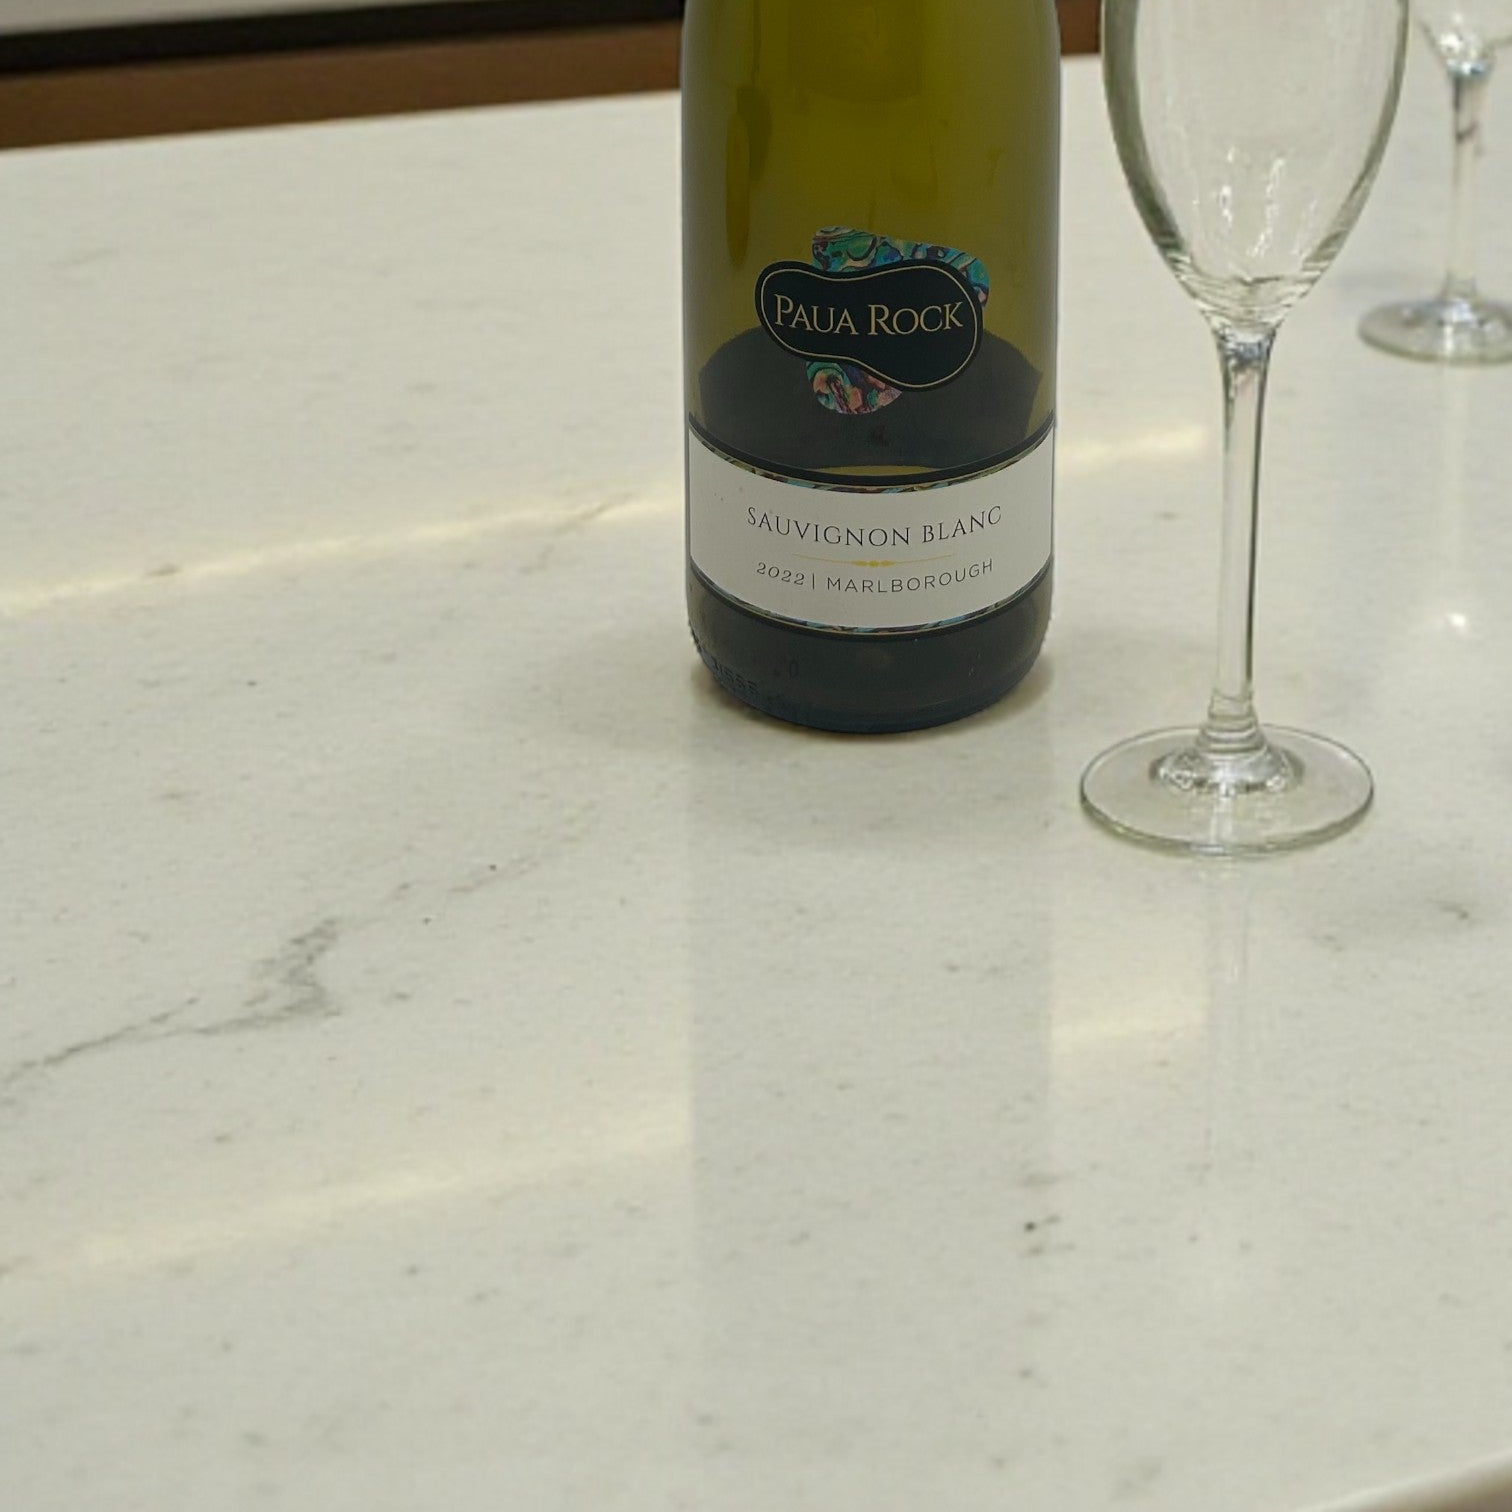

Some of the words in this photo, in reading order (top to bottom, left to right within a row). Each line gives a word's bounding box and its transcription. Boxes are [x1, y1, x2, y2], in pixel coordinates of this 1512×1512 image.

[773, 293, 859, 336] PAUA
[867, 301, 964, 336] ROCK
[747, 506, 911, 547] SAUVIGNON
[921, 505, 1002, 544] BLANC
[826, 558, 993, 593] MARLBOROUGH
